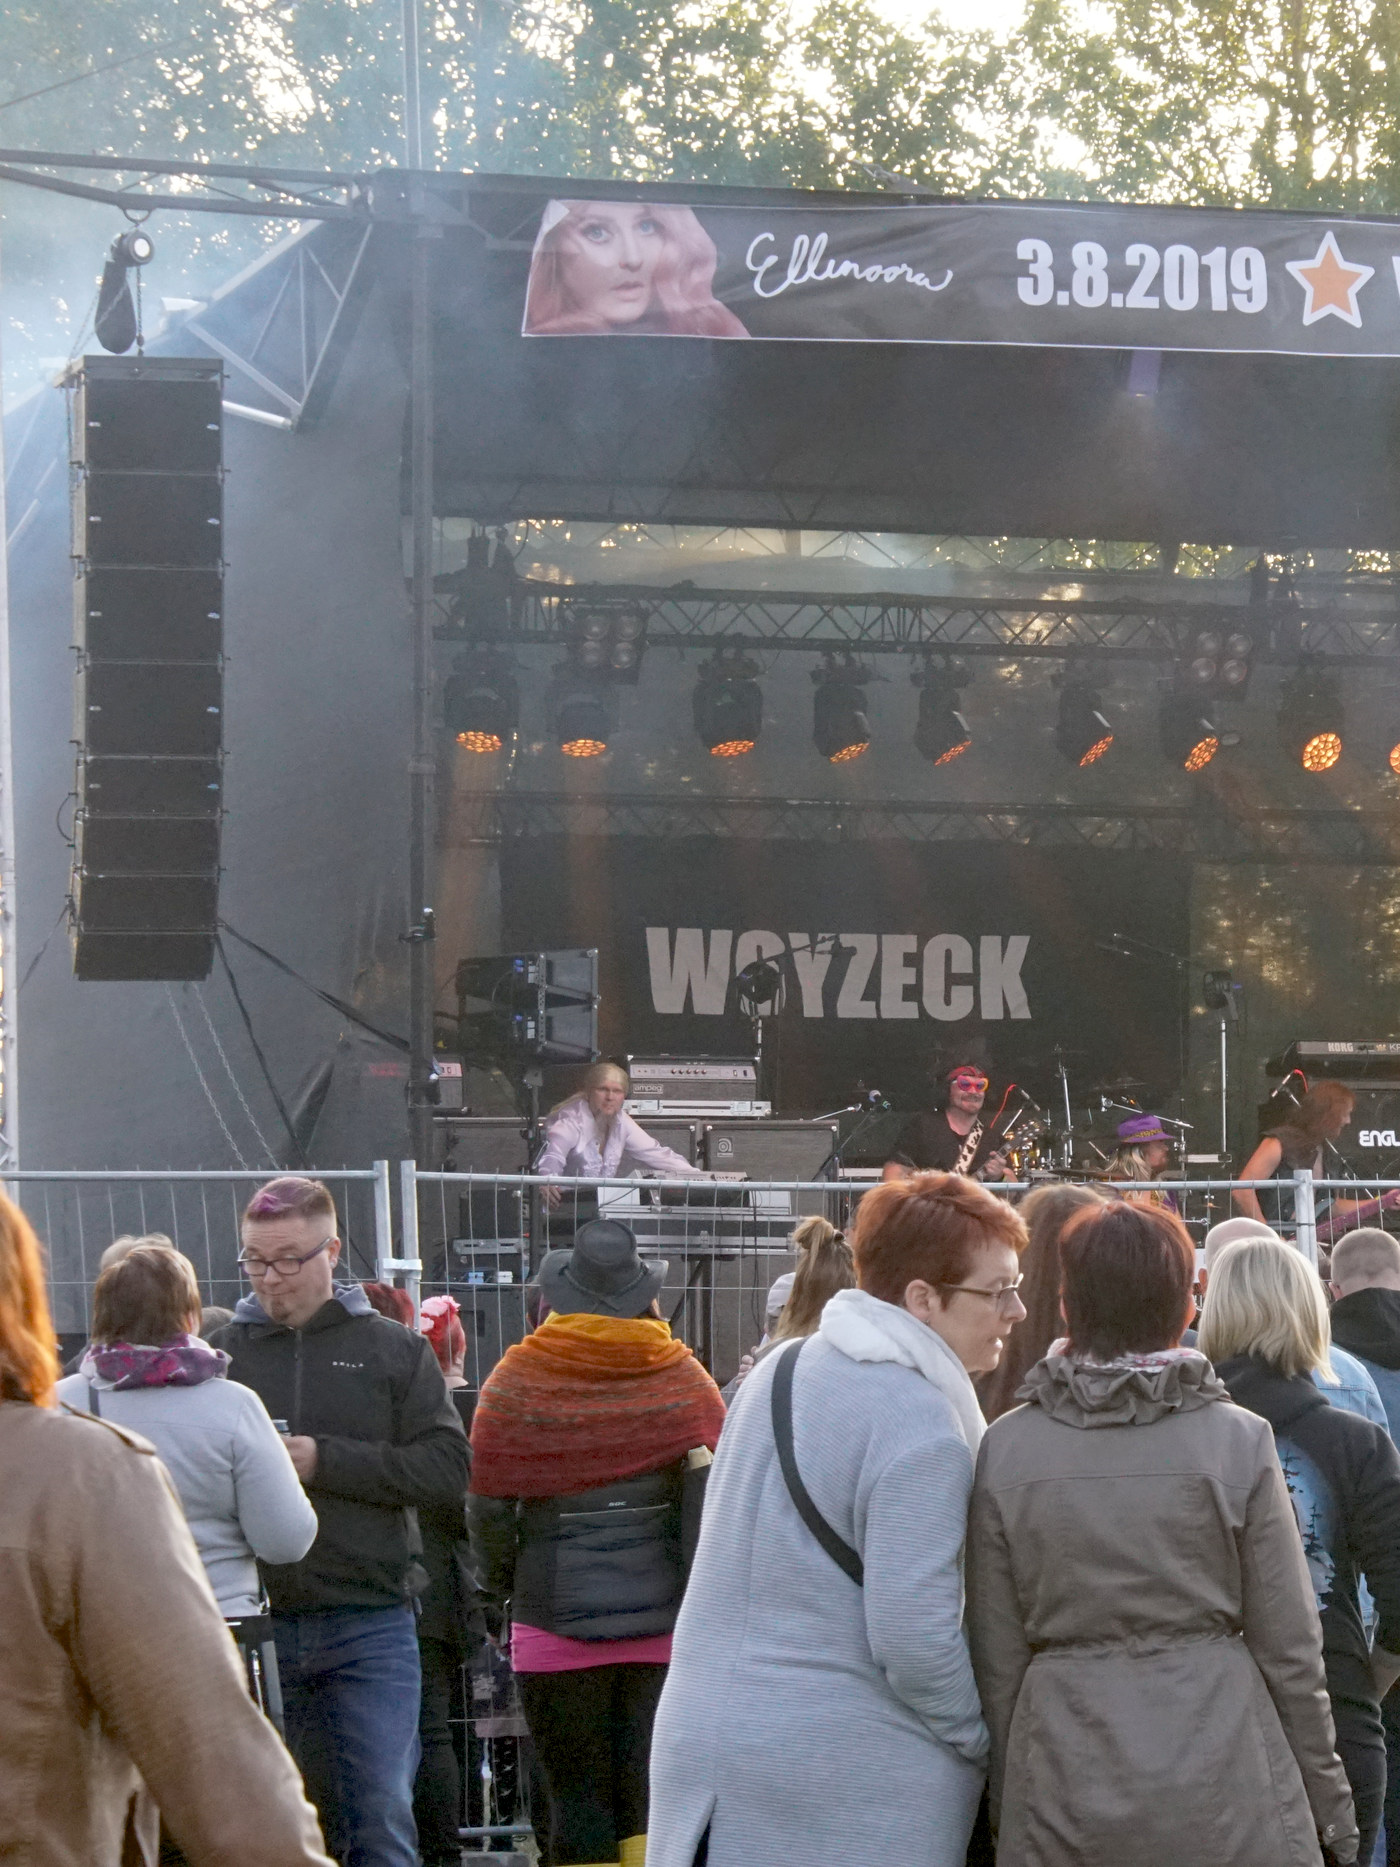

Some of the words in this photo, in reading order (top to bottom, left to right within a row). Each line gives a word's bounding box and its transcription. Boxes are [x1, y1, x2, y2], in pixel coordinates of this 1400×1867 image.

[746, 232, 953, 297] Ellinoora
[1016, 238, 1268, 314] 3.8.2019
[1327, 1042, 1354, 1052] KORG
[633, 1083, 663, 1094] ampeg
[1359, 1130, 1400, 1147] ENGL
